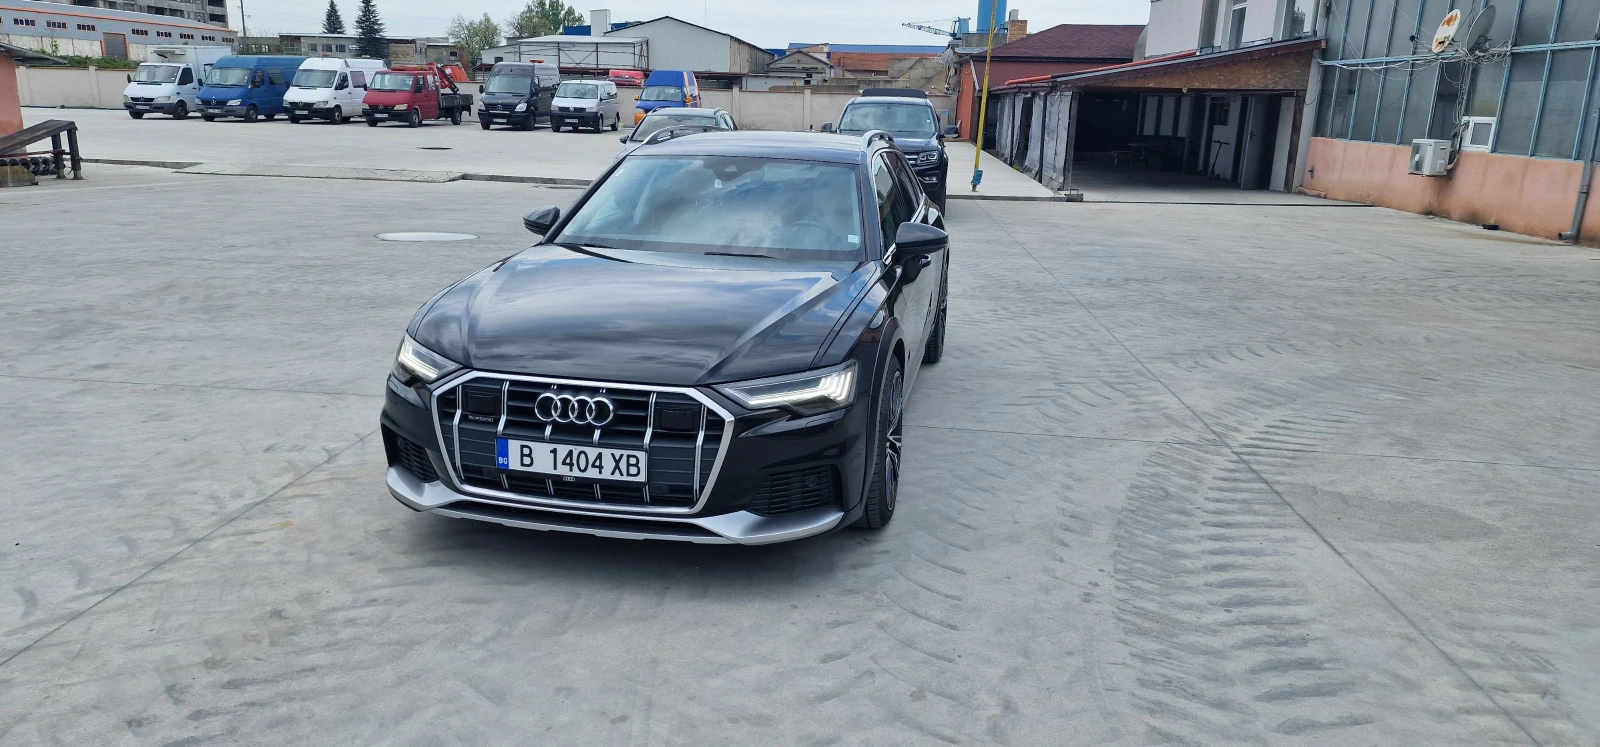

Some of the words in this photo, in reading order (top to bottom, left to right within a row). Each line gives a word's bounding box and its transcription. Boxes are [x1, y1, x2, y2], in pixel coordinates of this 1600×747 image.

[498, 457, 508, 465] BG
[520, 444, 534, 468] B
[549, 447, 604, 474] 1404
[610, 452, 641, 477] XB
